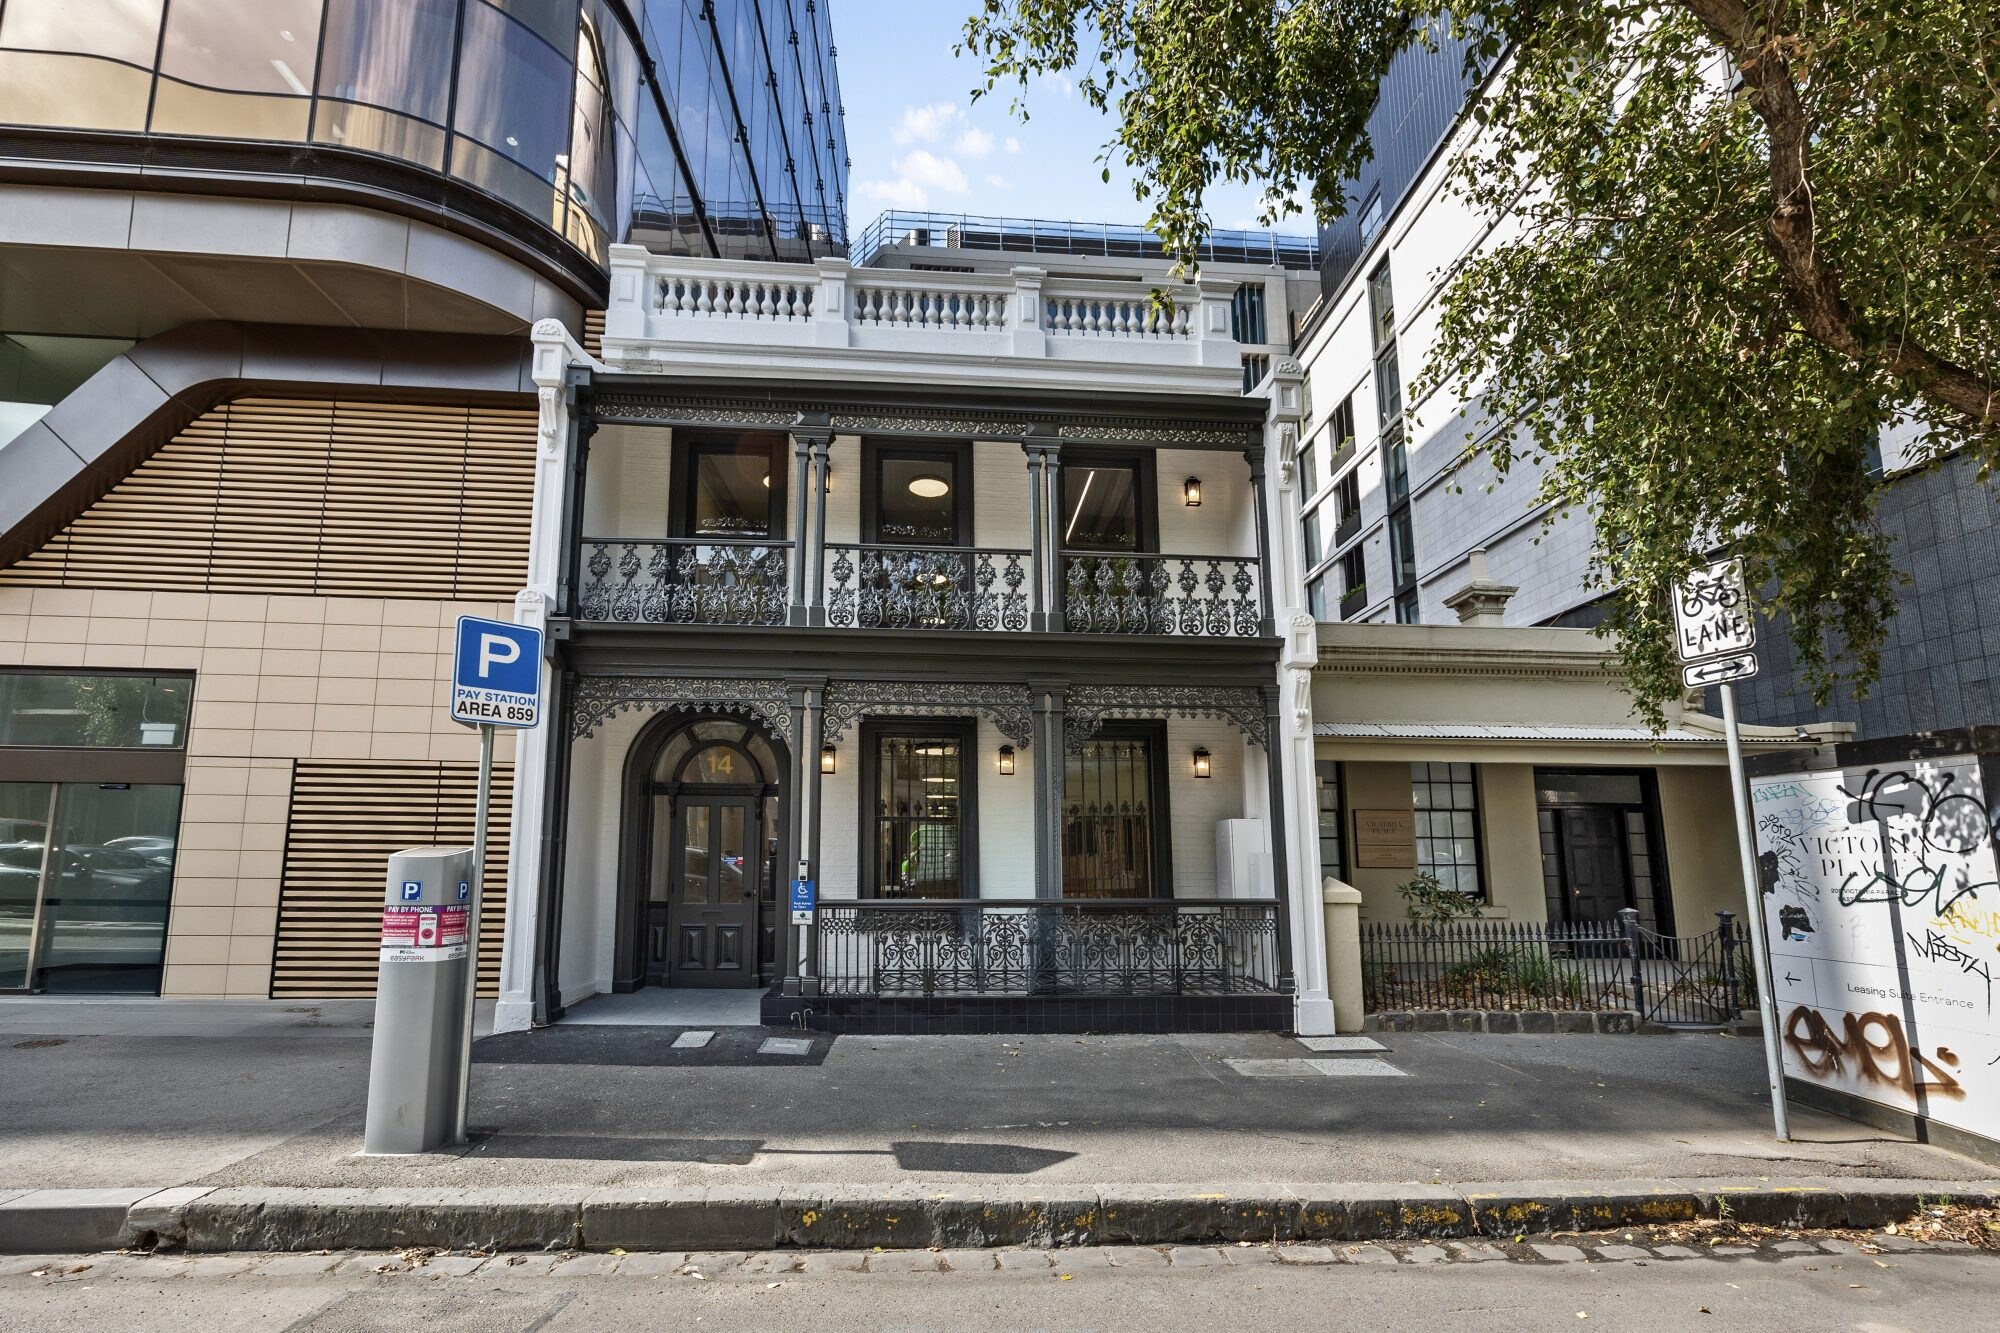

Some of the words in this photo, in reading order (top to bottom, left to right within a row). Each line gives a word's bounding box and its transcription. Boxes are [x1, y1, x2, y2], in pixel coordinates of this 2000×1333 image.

[1685, 615, 1746, 647] LANE
[479, 633, 520, 678] P
[457, 689, 481, 700] PAY
[485, 692, 536, 707] STATION
[457, 701, 502, 718] AREA
[507, 706, 534, 722] 859
[707, 755, 733, 774] 14
[1798, 835, 1931, 855] VICTORIA
[1821, 859, 1906, 877] PLACE
[1847, 983, 1886, 999] Leasing
[1889, 988, 1917, 1001] Suite
[1920, 992, 1974, 1009] Entrance
